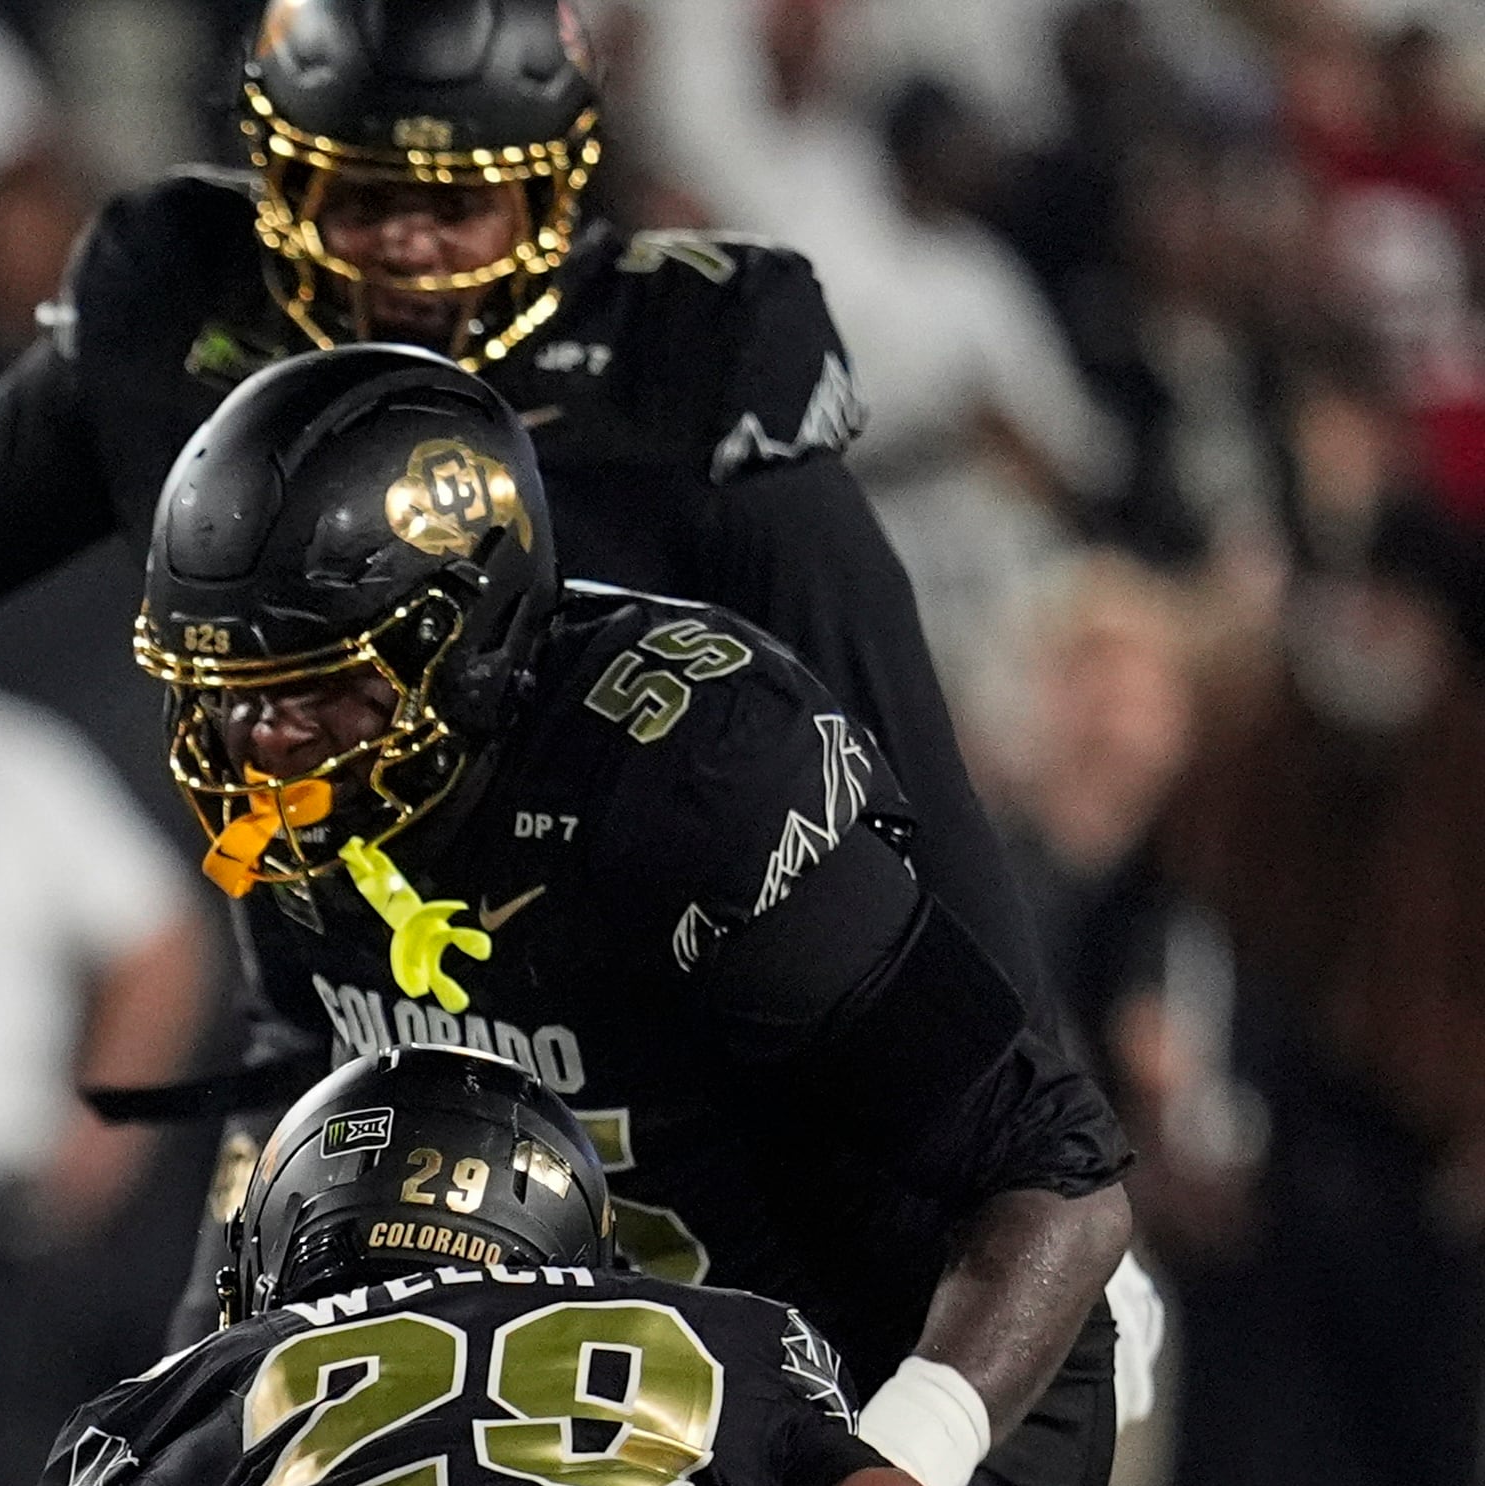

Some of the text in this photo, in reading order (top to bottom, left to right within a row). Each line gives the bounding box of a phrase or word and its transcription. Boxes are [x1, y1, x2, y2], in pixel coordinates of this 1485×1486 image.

[583, 618, 753, 745] 55
[514, 811, 579, 842] DP 7
[400, 1147, 491, 1215] 29
[368, 1221, 502, 1265] COLORADO
